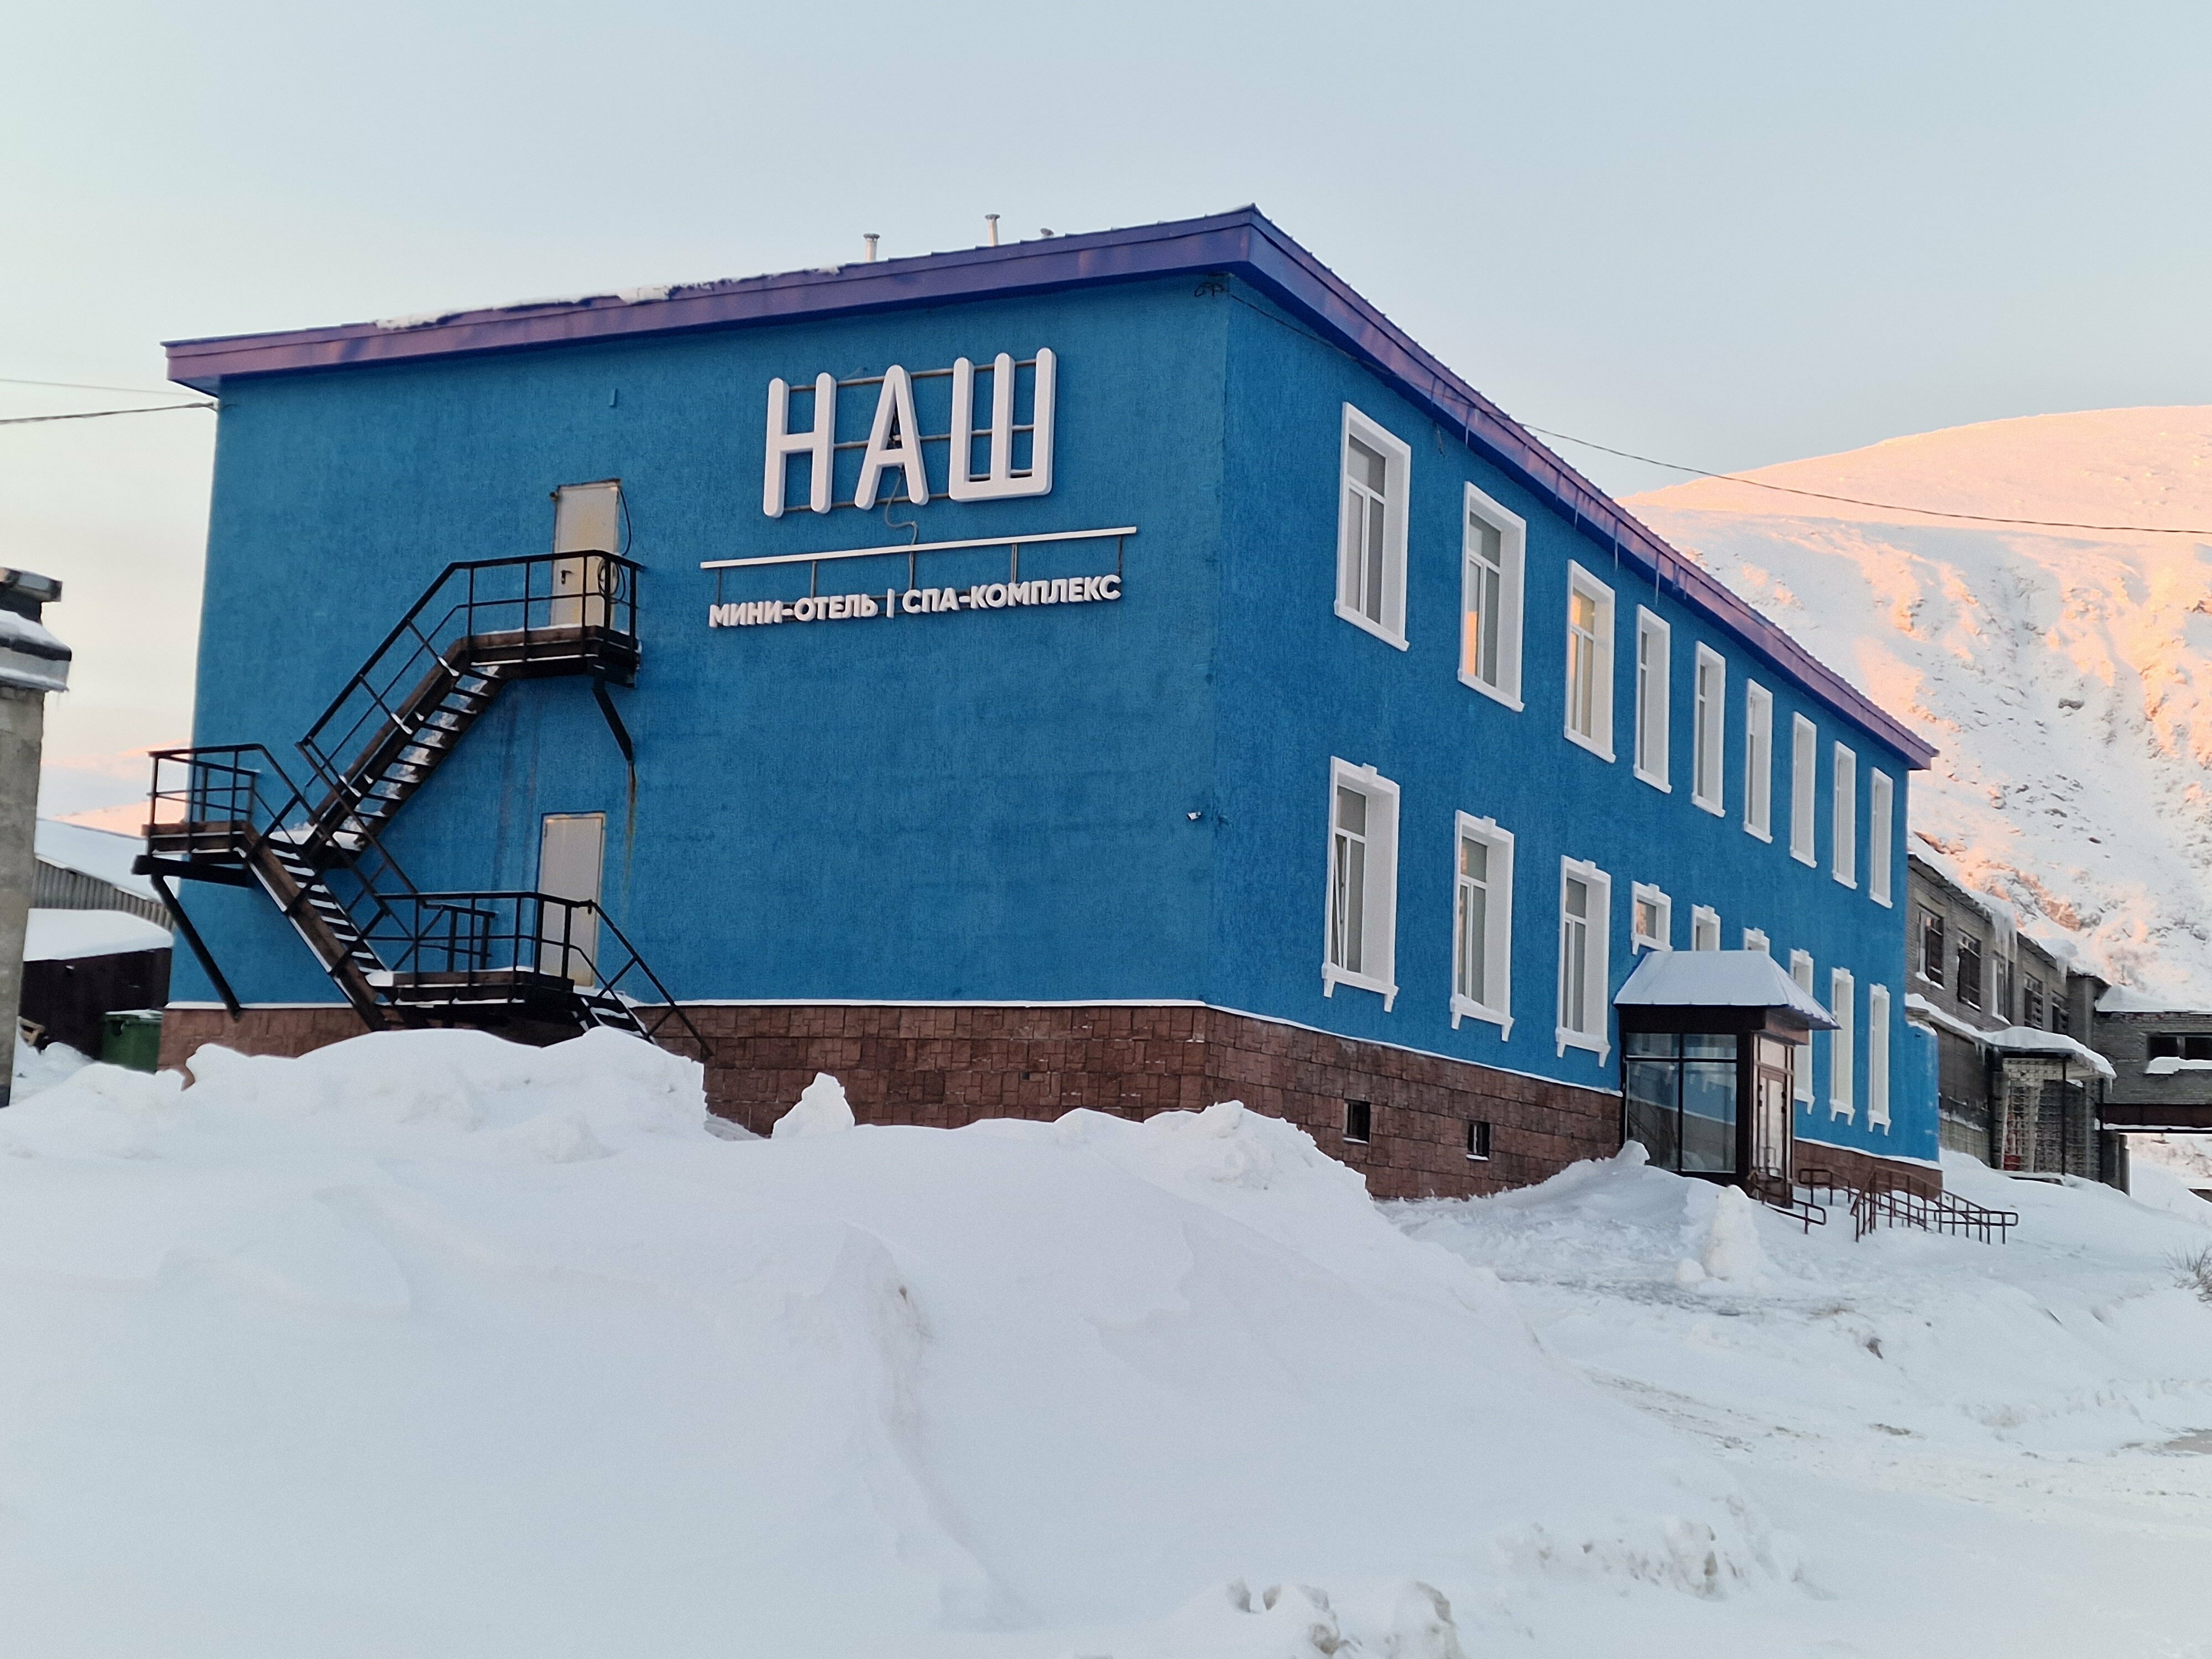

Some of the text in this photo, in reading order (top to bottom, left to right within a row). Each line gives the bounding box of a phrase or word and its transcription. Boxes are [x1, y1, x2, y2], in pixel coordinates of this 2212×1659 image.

[763, 347, 1057, 518] НАШ
[708, 593, 879, 628] МИНИ-ОТЕЛЬ
[902, 575, 1122, 615] СПА-КОМПЛЕКС
